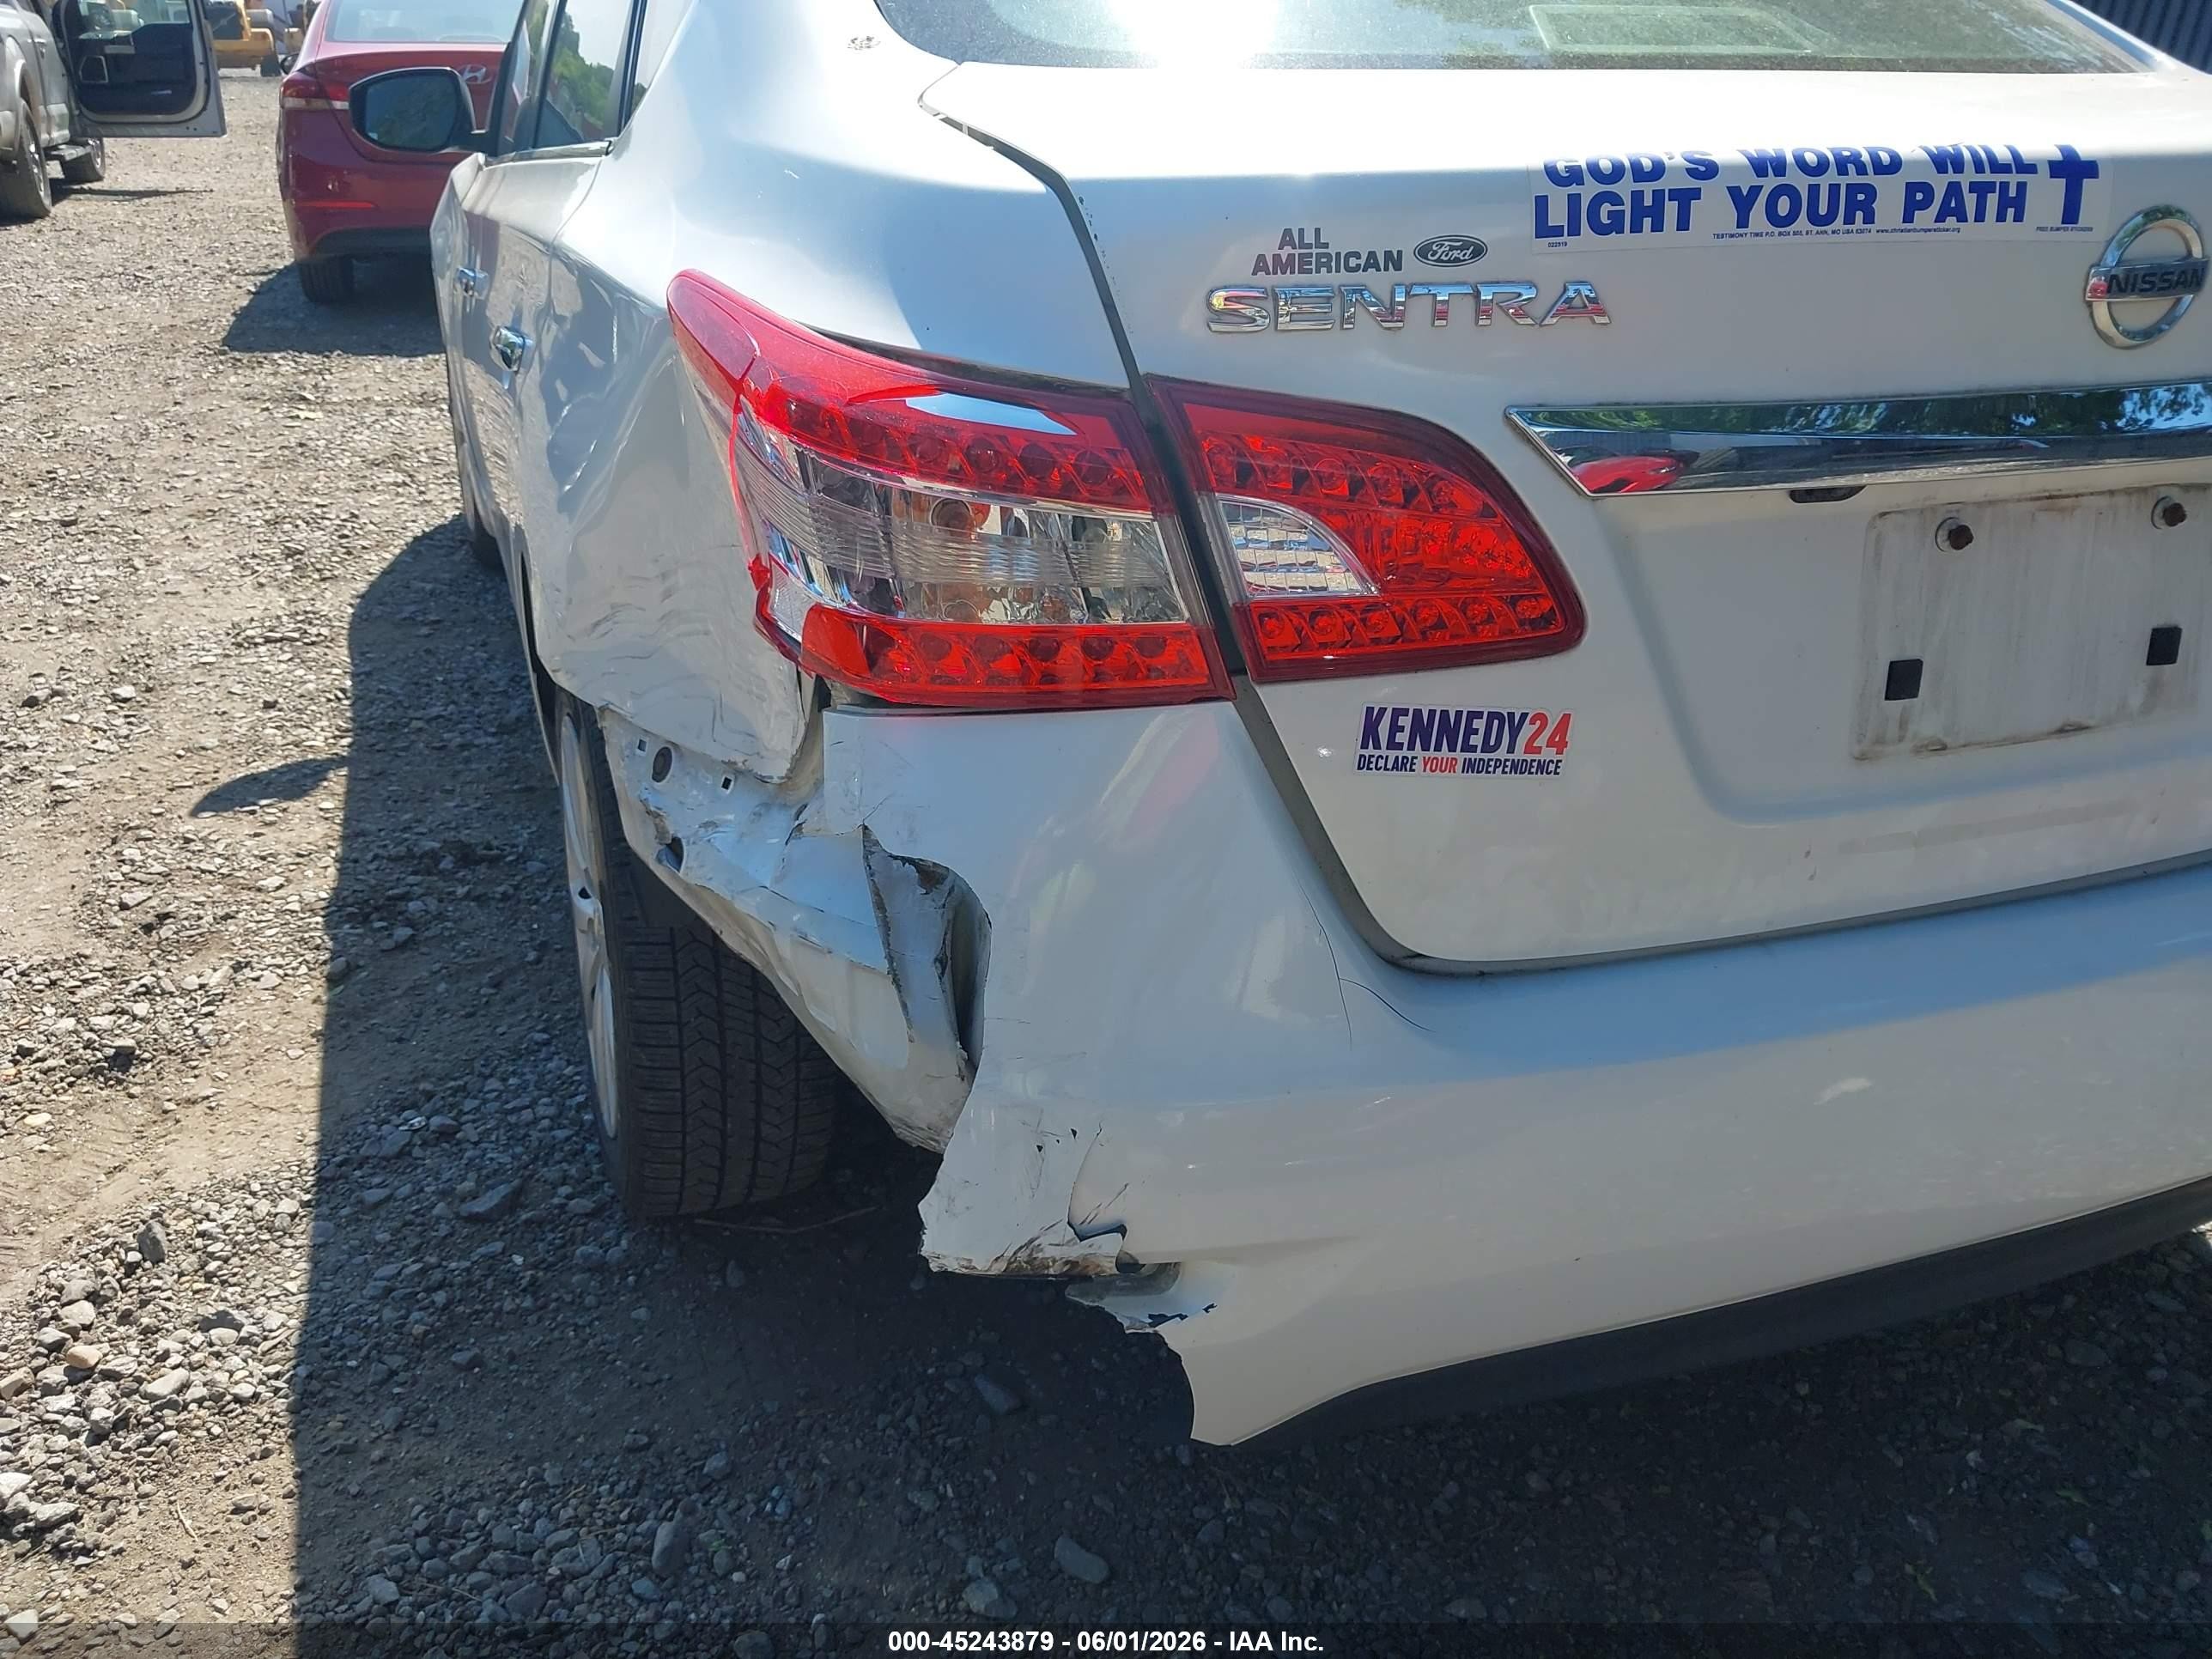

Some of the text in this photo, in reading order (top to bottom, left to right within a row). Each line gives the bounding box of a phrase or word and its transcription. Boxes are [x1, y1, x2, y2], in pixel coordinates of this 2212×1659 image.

[1544, 143, 2039, 188] GOD'S WORD WILL
[1534, 180, 2028, 239] LIGHT YOUR PATH
[1278, 228, 1329, 250] ALL
[1427, 241, 1474, 260] Ford
[1251, 249, 1403, 276] AMERICAN
[2106, 268, 2204, 293] NISSAN
[1206, 282, 1613, 332] SENTRA
[1357, 754, 1562, 775] DECLARE YOUR INDEPENDENCE
